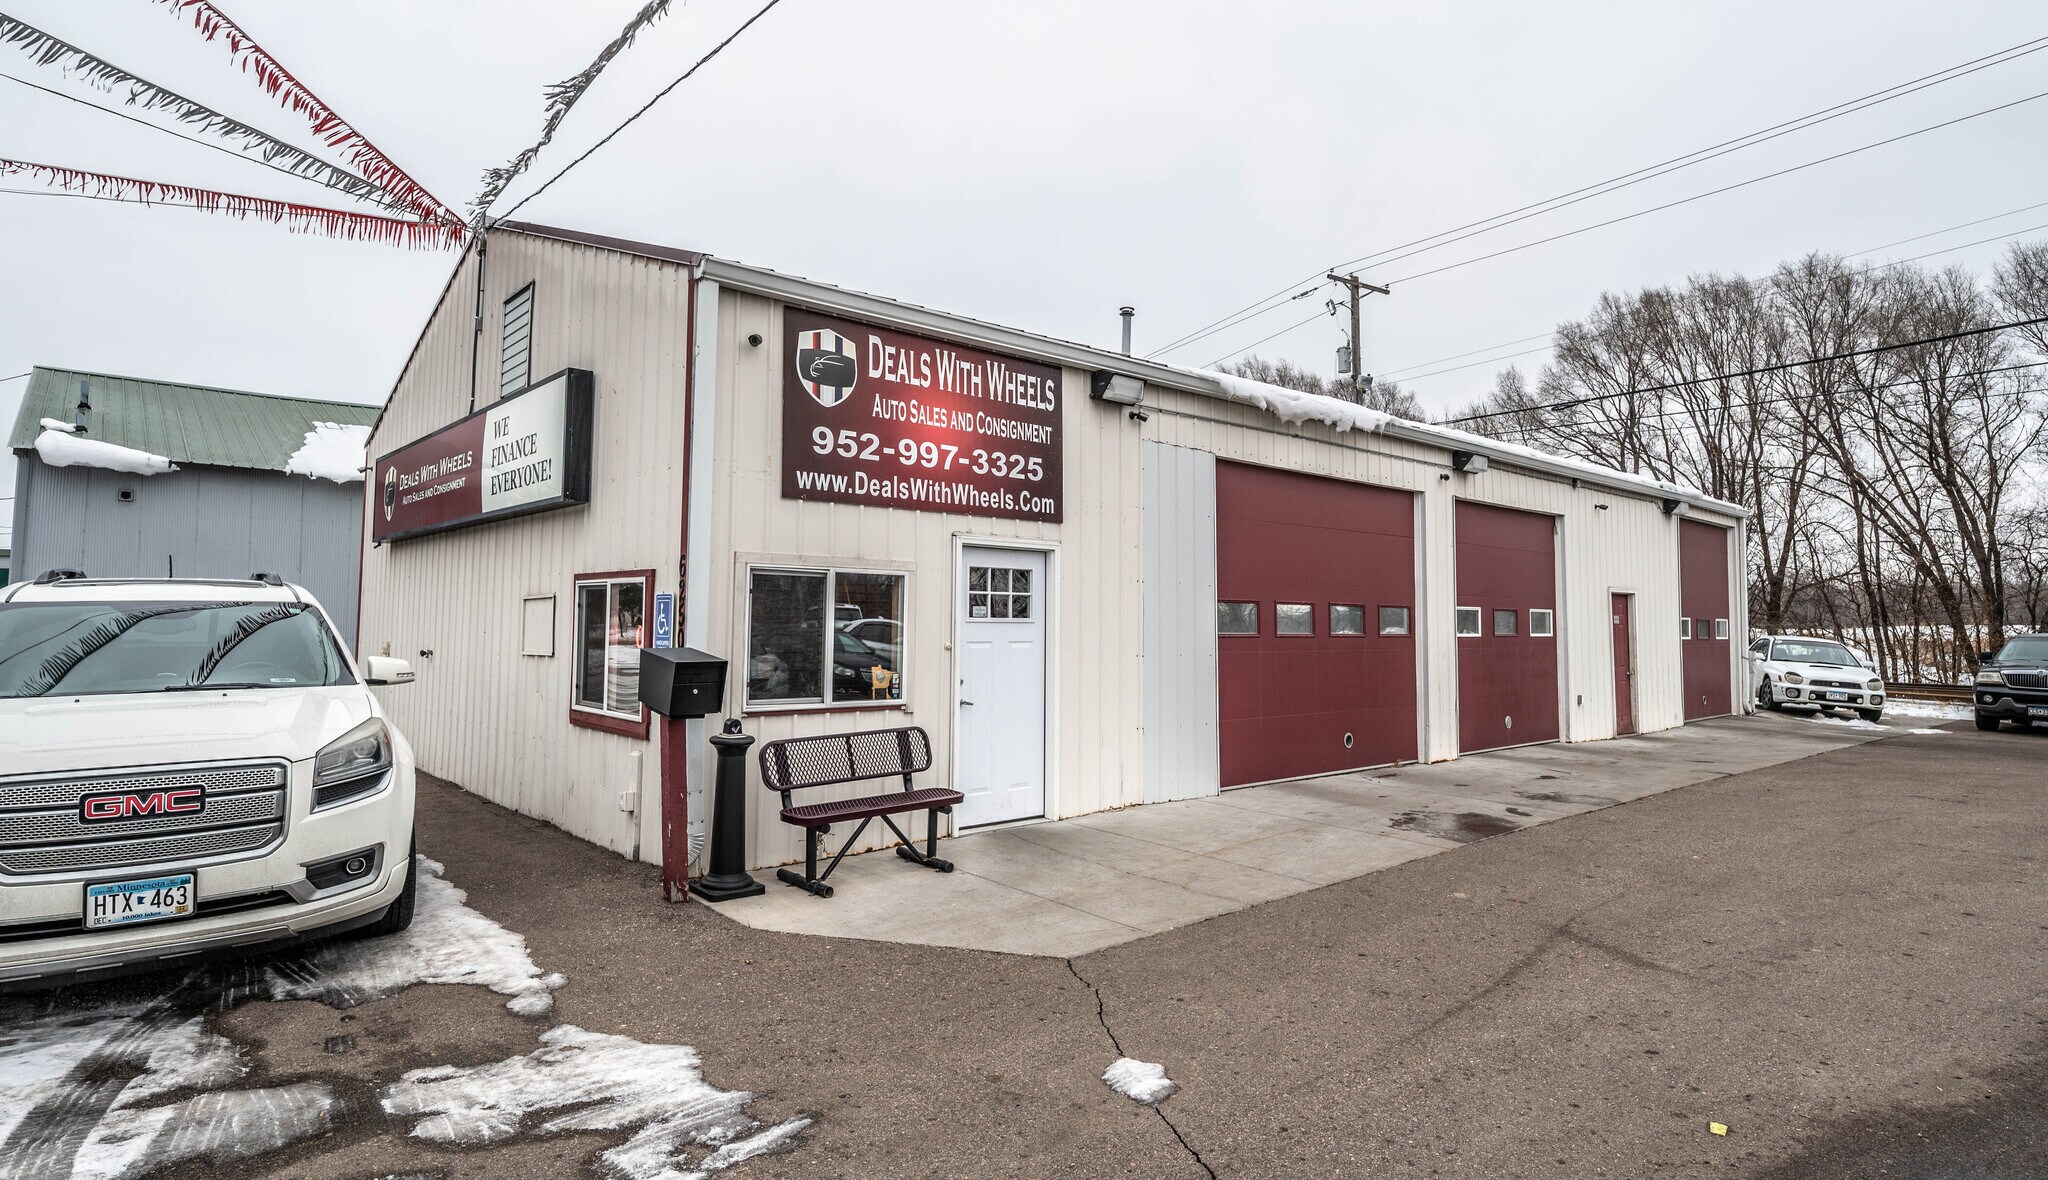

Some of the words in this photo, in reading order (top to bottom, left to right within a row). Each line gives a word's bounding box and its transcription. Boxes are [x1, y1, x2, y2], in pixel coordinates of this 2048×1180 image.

[868, 335, 931, 389] DEALS
[935, 348, 982, 398] WITH
[986, 360, 1055, 412] WHEELS
[494, 416, 510, 440] WE
[872, 394, 907, 422] AUTO
[910, 400, 947, 428] SALES
[950, 411, 974, 432] AND
[976, 411, 1052, 445] CONSIGNMENT
[491, 433, 538, 468] FINANCE
[812, 426, 1044, 482] 952-997-3325
[399, 471, 420, 491] DEALS
[421, 465, 439, 483] WITH
[440, 450, 473, 476] WHEELS
[434, 477, 466, 495] CONSIGNMENT
[491, 458, 552, 496] EVERYONE!
[796, 470, 1055, 514] www.DealsWithWheels.Com
[85, 789, 201, 819] GMC
[94, 892, 133, 917] HTX
[150, 886, 187, 908] 463
[117, 881, 165, 892] Minnesota
[94, 917, 106, 925] DEC
